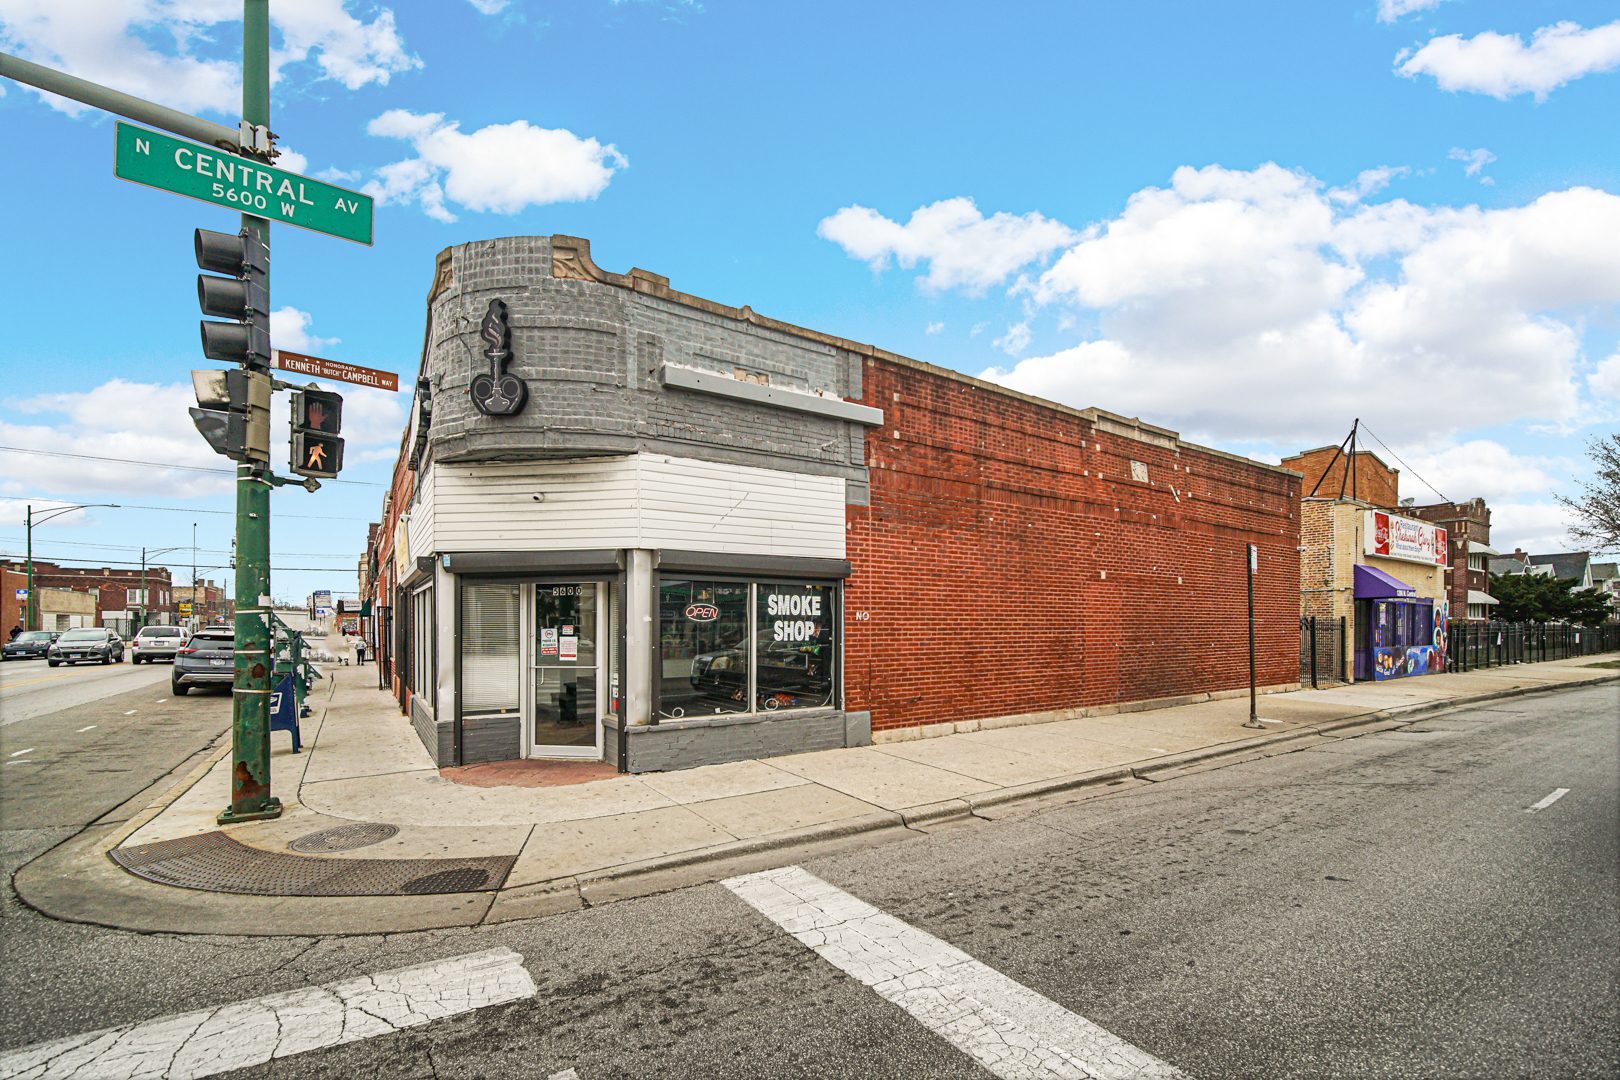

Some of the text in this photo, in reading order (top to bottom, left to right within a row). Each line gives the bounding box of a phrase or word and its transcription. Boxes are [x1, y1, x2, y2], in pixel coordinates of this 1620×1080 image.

[136, 138, 359, 214] N CENTRAL AV
[212, 182, 295, 218] 5600 W
[285, 358, 321, 375] KENNETH
[342, 370, 379, 386] CAMPBELL
[381, 379, 393, 387] WAY
[325, 361, 357, 372] HONORARY
[1400, 519, 1418, 532] Restaurant
[552, 587, 582, 596] 5600
[685, 606, 719, 618] OPEN
[767, 594, 822, 616] SMOKE
[856, 611, 870, 621] NO
[774, 620, 815, 642] SHOP
